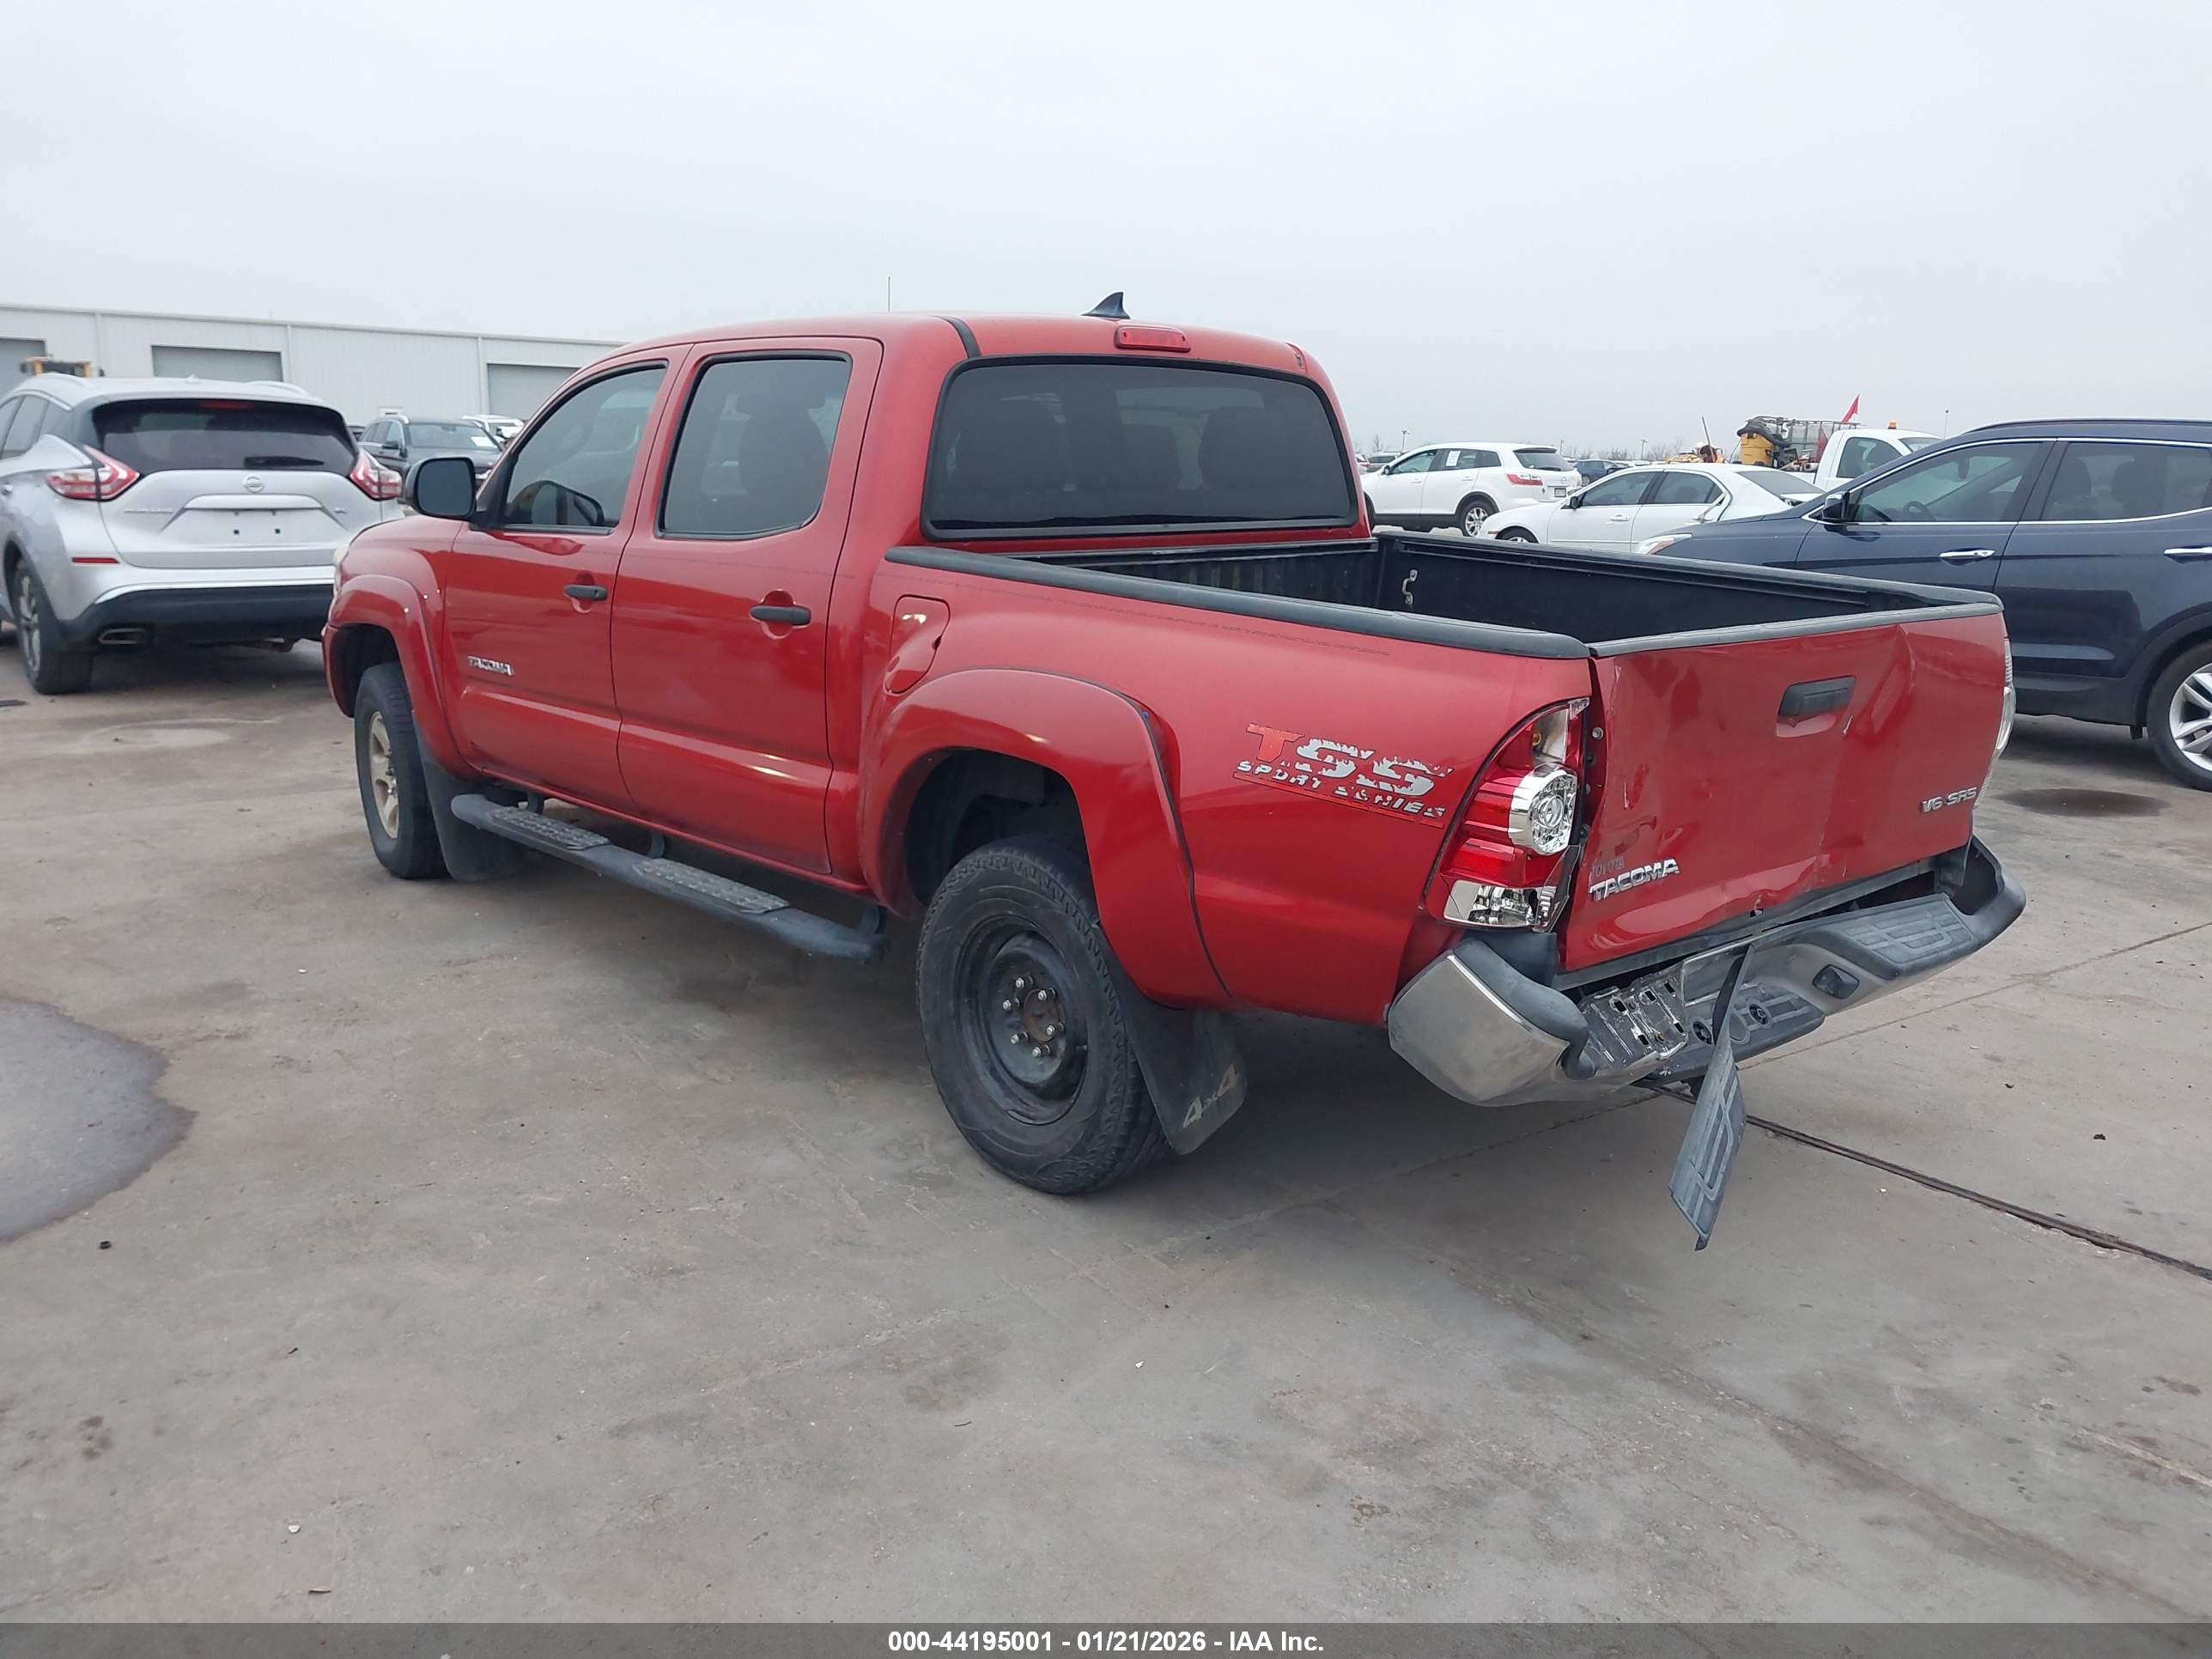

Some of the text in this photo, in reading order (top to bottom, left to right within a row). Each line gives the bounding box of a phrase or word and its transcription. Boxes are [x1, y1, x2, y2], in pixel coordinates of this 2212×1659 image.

[1237, 760, 1322, 789] SPORT
[1923, 796, 1943, 813] V6
[1589, 859, 1680, 902] TACOMA
